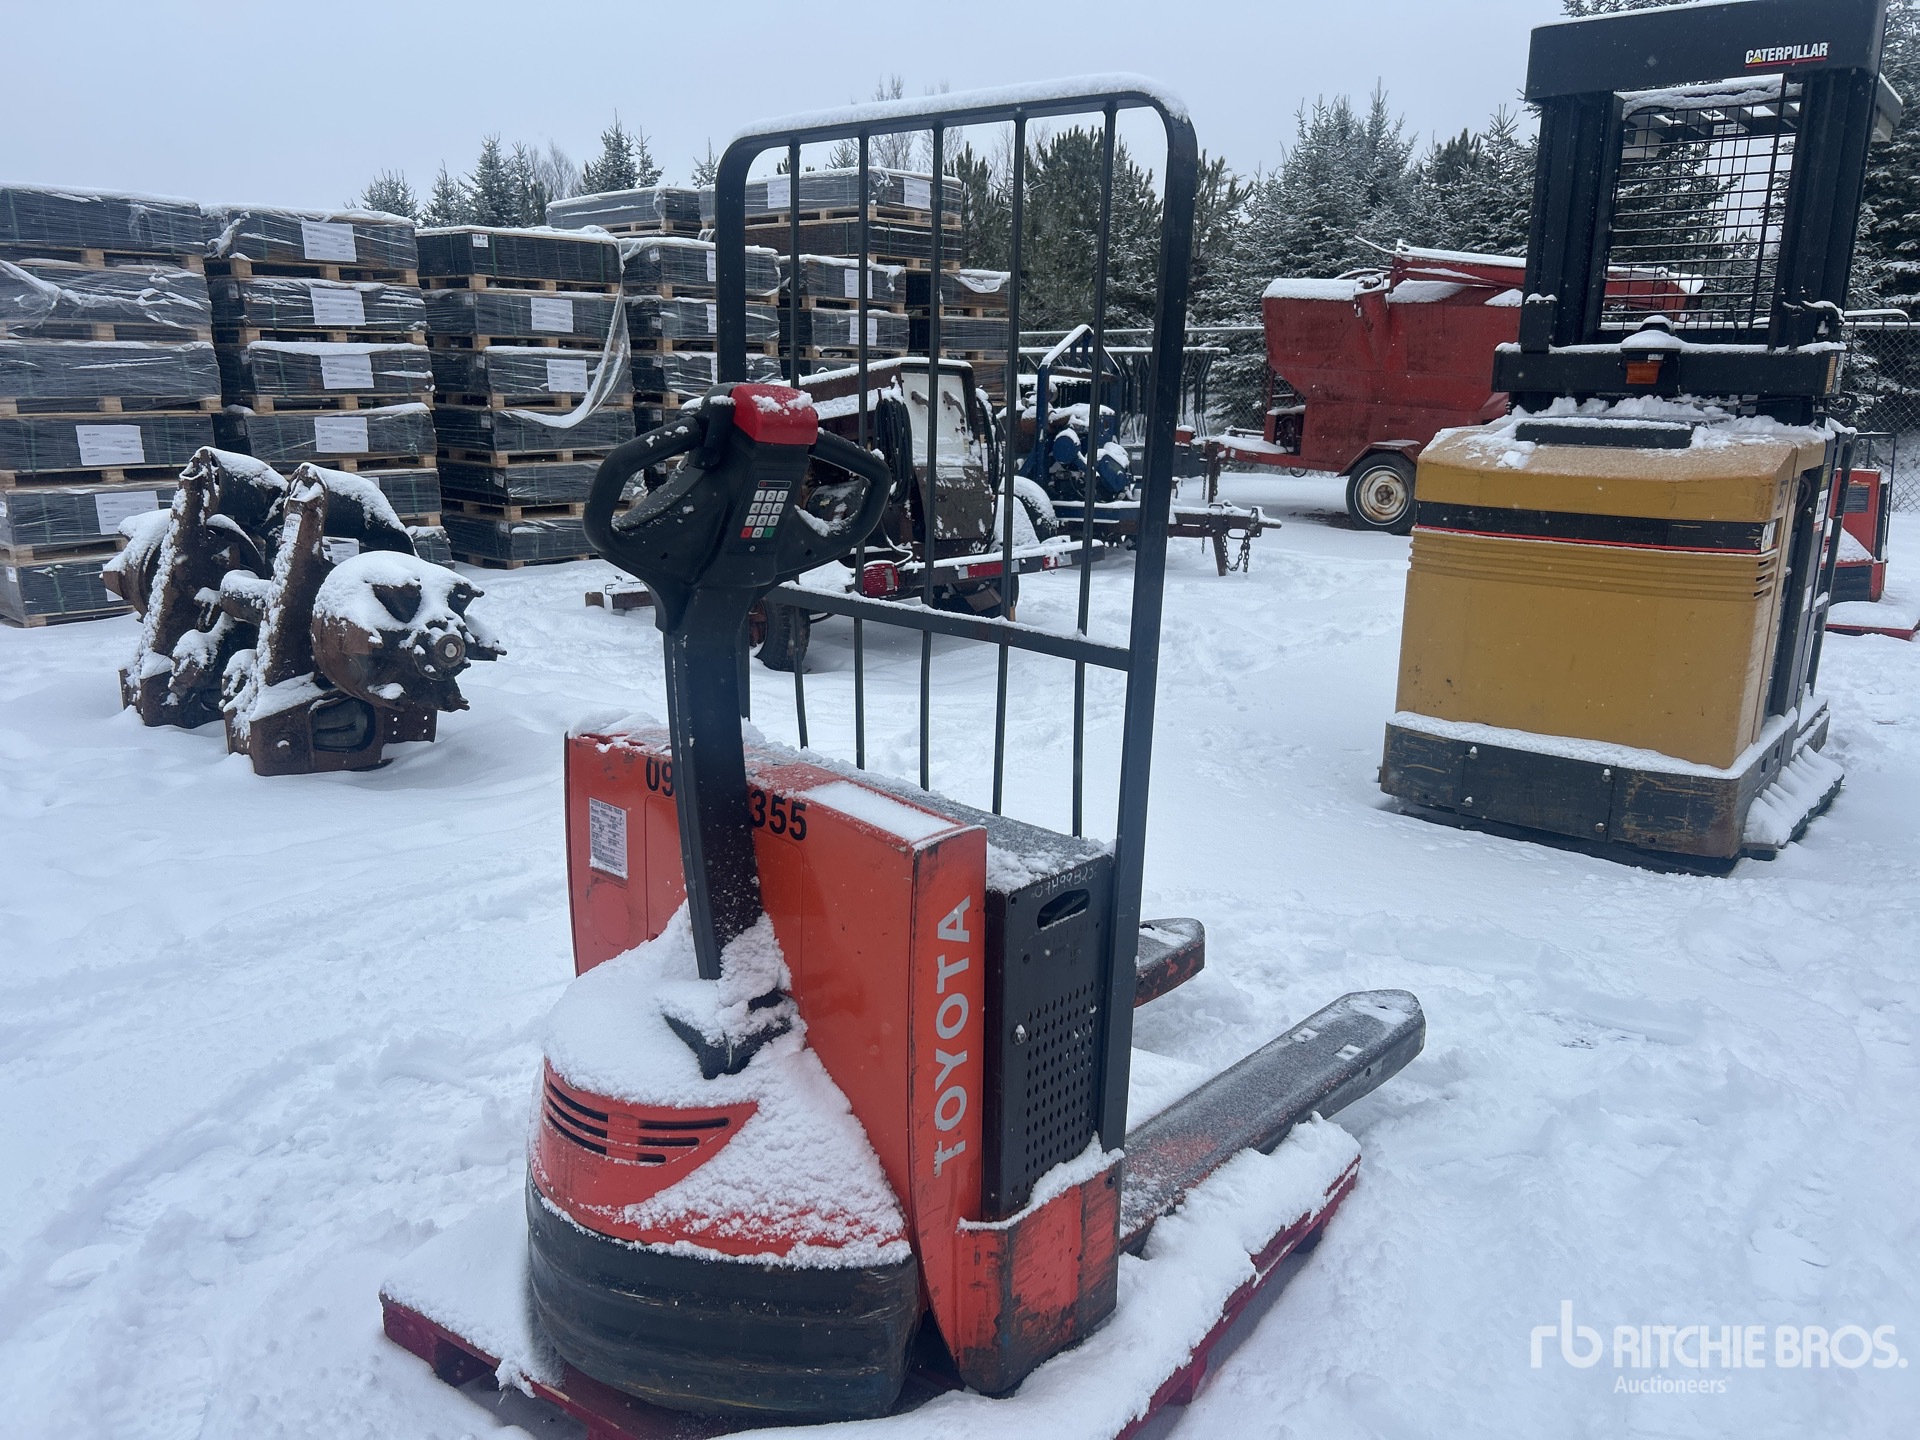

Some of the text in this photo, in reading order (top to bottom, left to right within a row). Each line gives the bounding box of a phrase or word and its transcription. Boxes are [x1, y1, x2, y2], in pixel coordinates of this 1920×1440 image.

[1745, 42, 1828, 64] CATERPILLAR
[750, 789, 807, 841] 355
[933, 895, 971, 1178] TOYOTA
